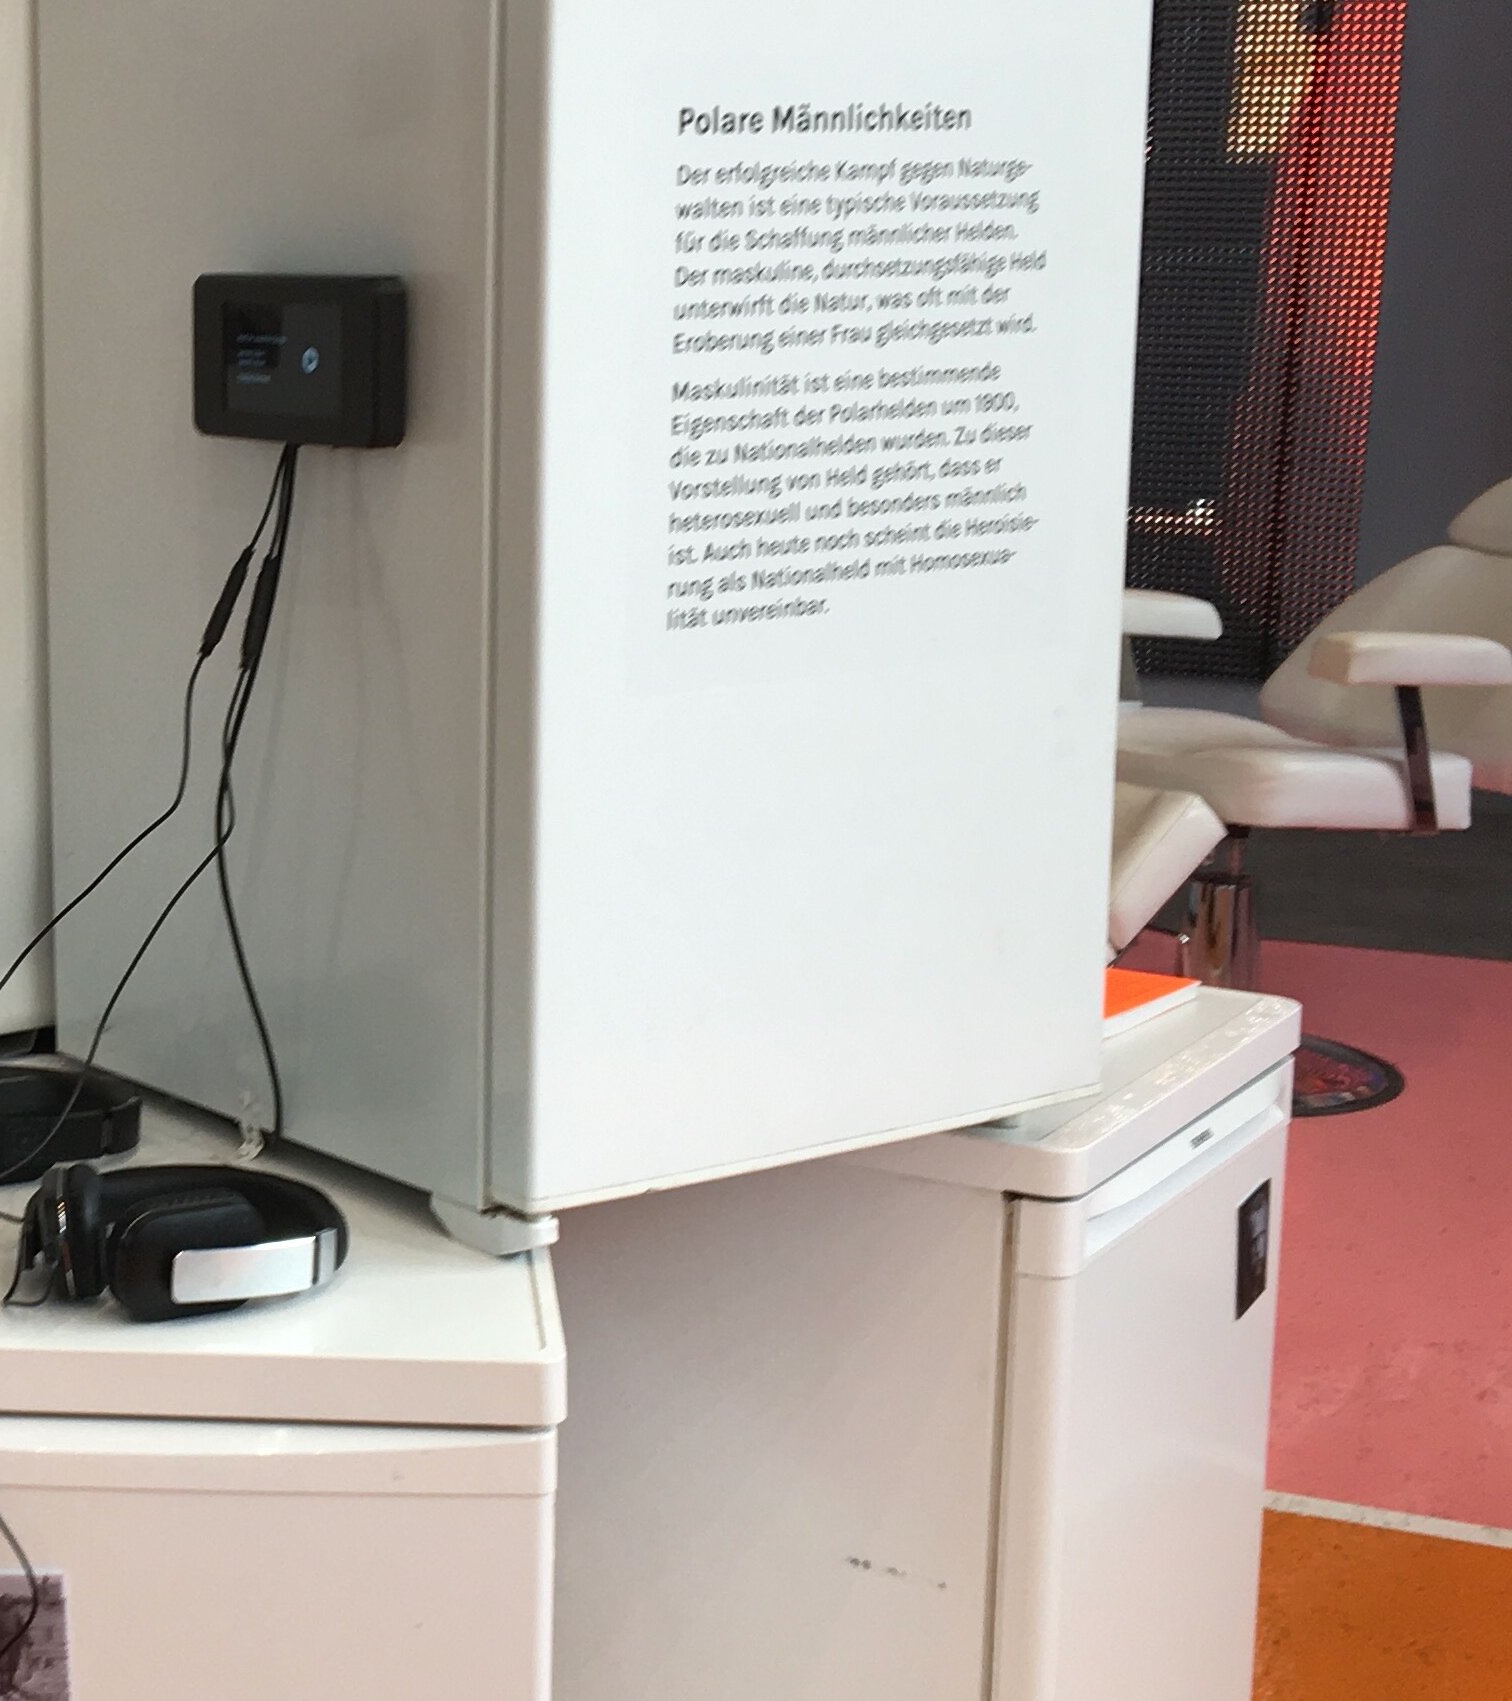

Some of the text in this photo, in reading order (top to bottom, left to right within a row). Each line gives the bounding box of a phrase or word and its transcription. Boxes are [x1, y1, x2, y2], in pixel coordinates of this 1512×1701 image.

[678, 101, 972, 136] Polare Männlichkeiten
[676, 157, 1033, 190] Der erfolgreiche Kampf gegen Naturge-
[674, 190, 1040, 221] walten ist eine typische Voraussetzung
[675, 220, 1019, 254] für die Schaffung männlicher Helden.
[674, 250, 1047, 288] Der maskuline, durchsetzungsfähige Held
[673, 283, 1011, 321] unterwirft die Natur, was oft mit der
[672, 312, 1038, 355] Eroberung einer Frau gleichgesetzt wird.
[671, 361, 1001, 403] Maskulinität ist eine bestimmende
[671, 407, 789, 440] Eigenschaft
[793, 405, 826, 427] der
[829, 397, 937, 424] Polarhelden
[941, 398, 971, 416] um
[669, 422, 1033, 469] die zu Nationalhelden wurden. Zu dieser
[668, 457, 1003, 501] Vorstellung von Held gehört, dass er
[668, 482, 1026, 534] heterosexuell und besonders männlich
[668, 512, 1040, 566] ist. Auch heute noch scheint die Heroisie-
[667, 548, 1017, 602] rung als Nationalheld mit Homosexua-
[666, 594, 830, 631] lität unvereinbar.
